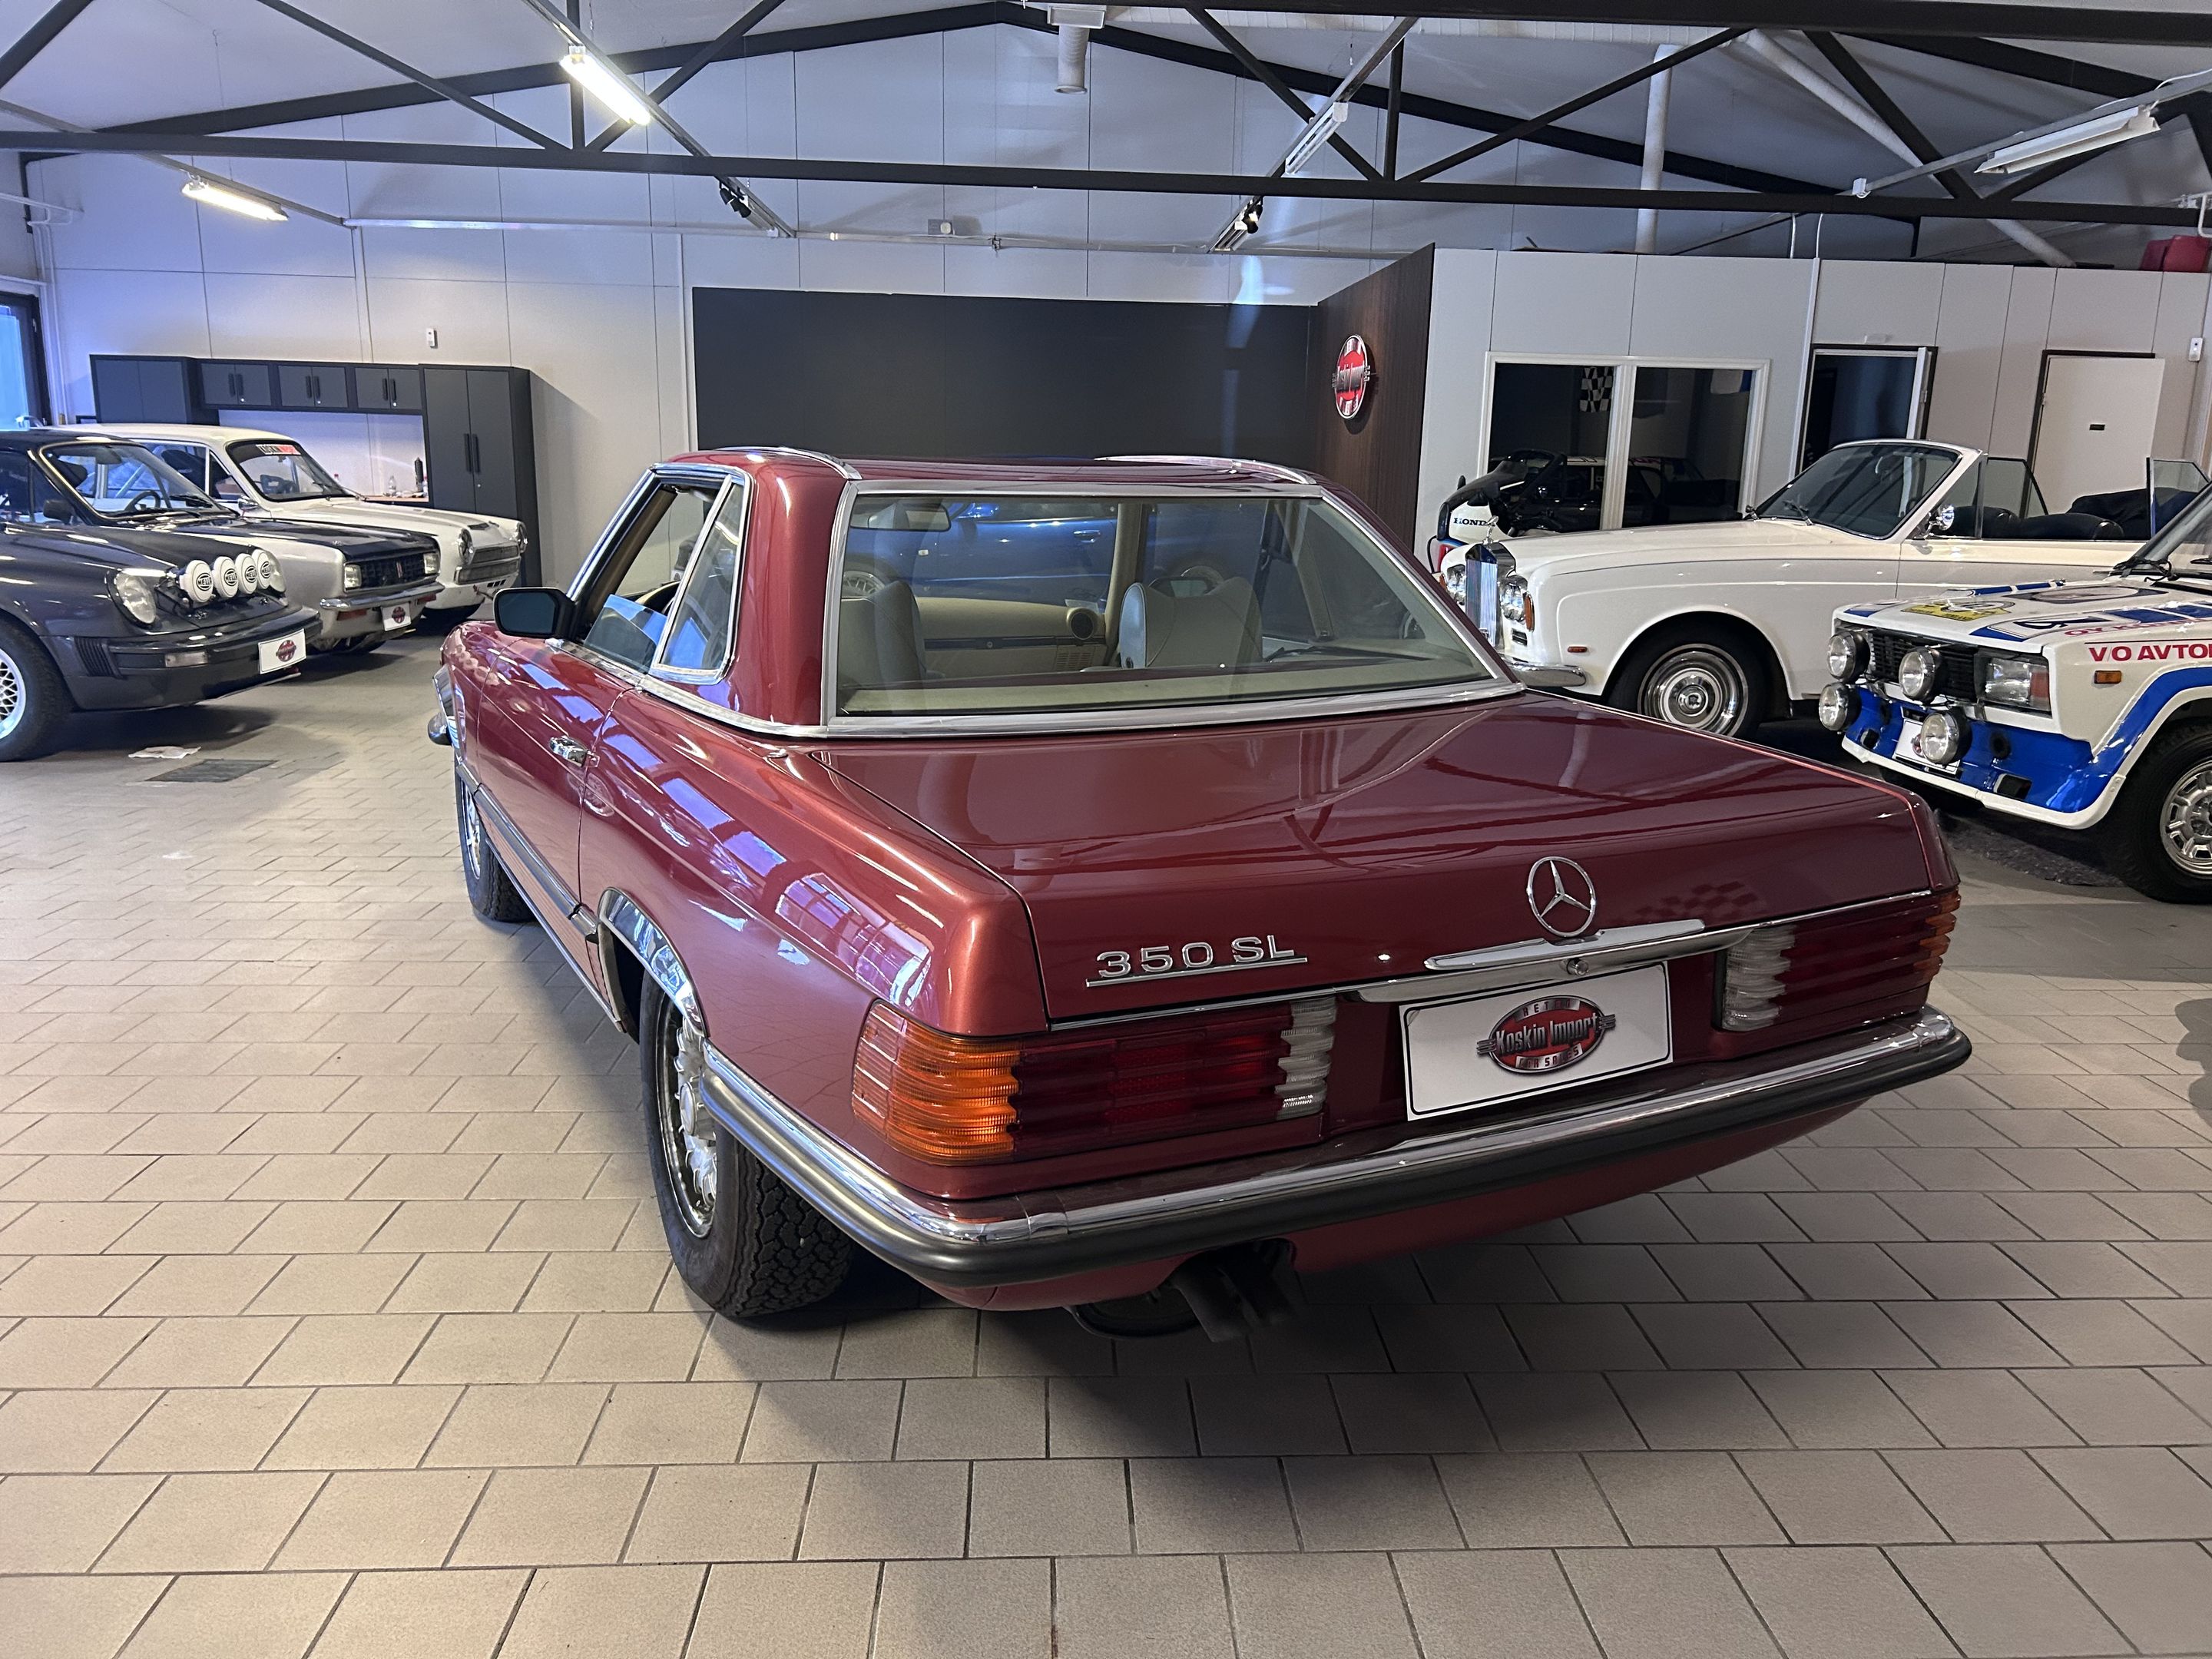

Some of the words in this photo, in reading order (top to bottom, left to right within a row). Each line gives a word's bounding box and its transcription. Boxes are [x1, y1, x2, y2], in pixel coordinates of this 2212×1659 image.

[1454, 518, 1494, 526] HOND
[2137, 643, 2212, 661] AVTO
[1097, 942, 1214, 978] 350
[1231, 935, 1295, 962] SL
[1523, 999, 1572, 1017] RETRO
[1495, 1024, 1546, 1055] Koskin
[1550, 1012, 1598, 1046] Import
